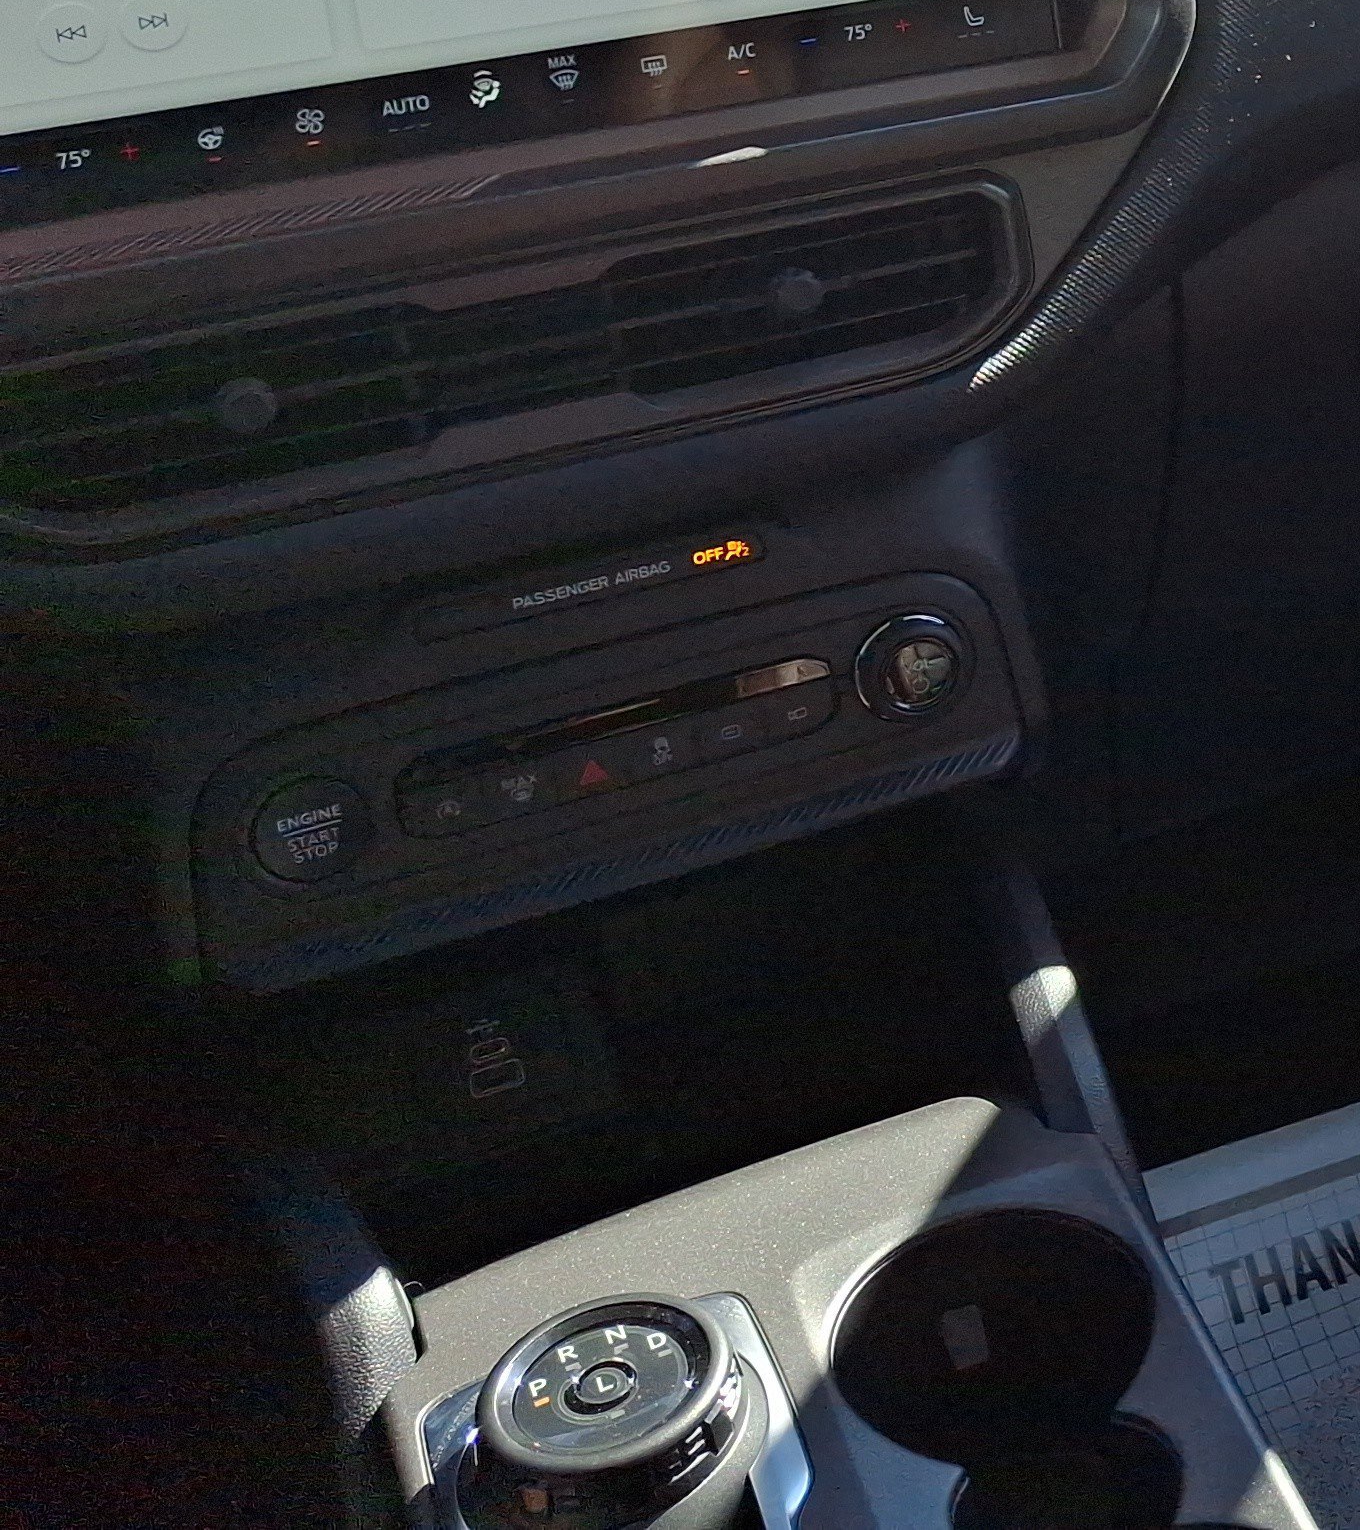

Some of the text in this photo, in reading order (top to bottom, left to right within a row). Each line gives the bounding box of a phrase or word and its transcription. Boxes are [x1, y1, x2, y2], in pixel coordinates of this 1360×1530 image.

[844, 23, 873, 42] 75°
[547, 54, 577, 69] MAX
[728, 42, 757, 61] A/C
[382, 94, 430, 117] AUTO
[55, 148, 91, 170] 75°
[512, 575, 610, 610] PASSENGER
[615, 561, 671, 585] AIRBAG
[693, 546, 724, 565] OFF
[276, 803, 342, 832] ENGINE
[288, 827, 340, 853] START
[294, 841, 339, 864] STOP
[529, 1324, 667, 1398] P R N D
[595, 1376, 615, 1393] L
